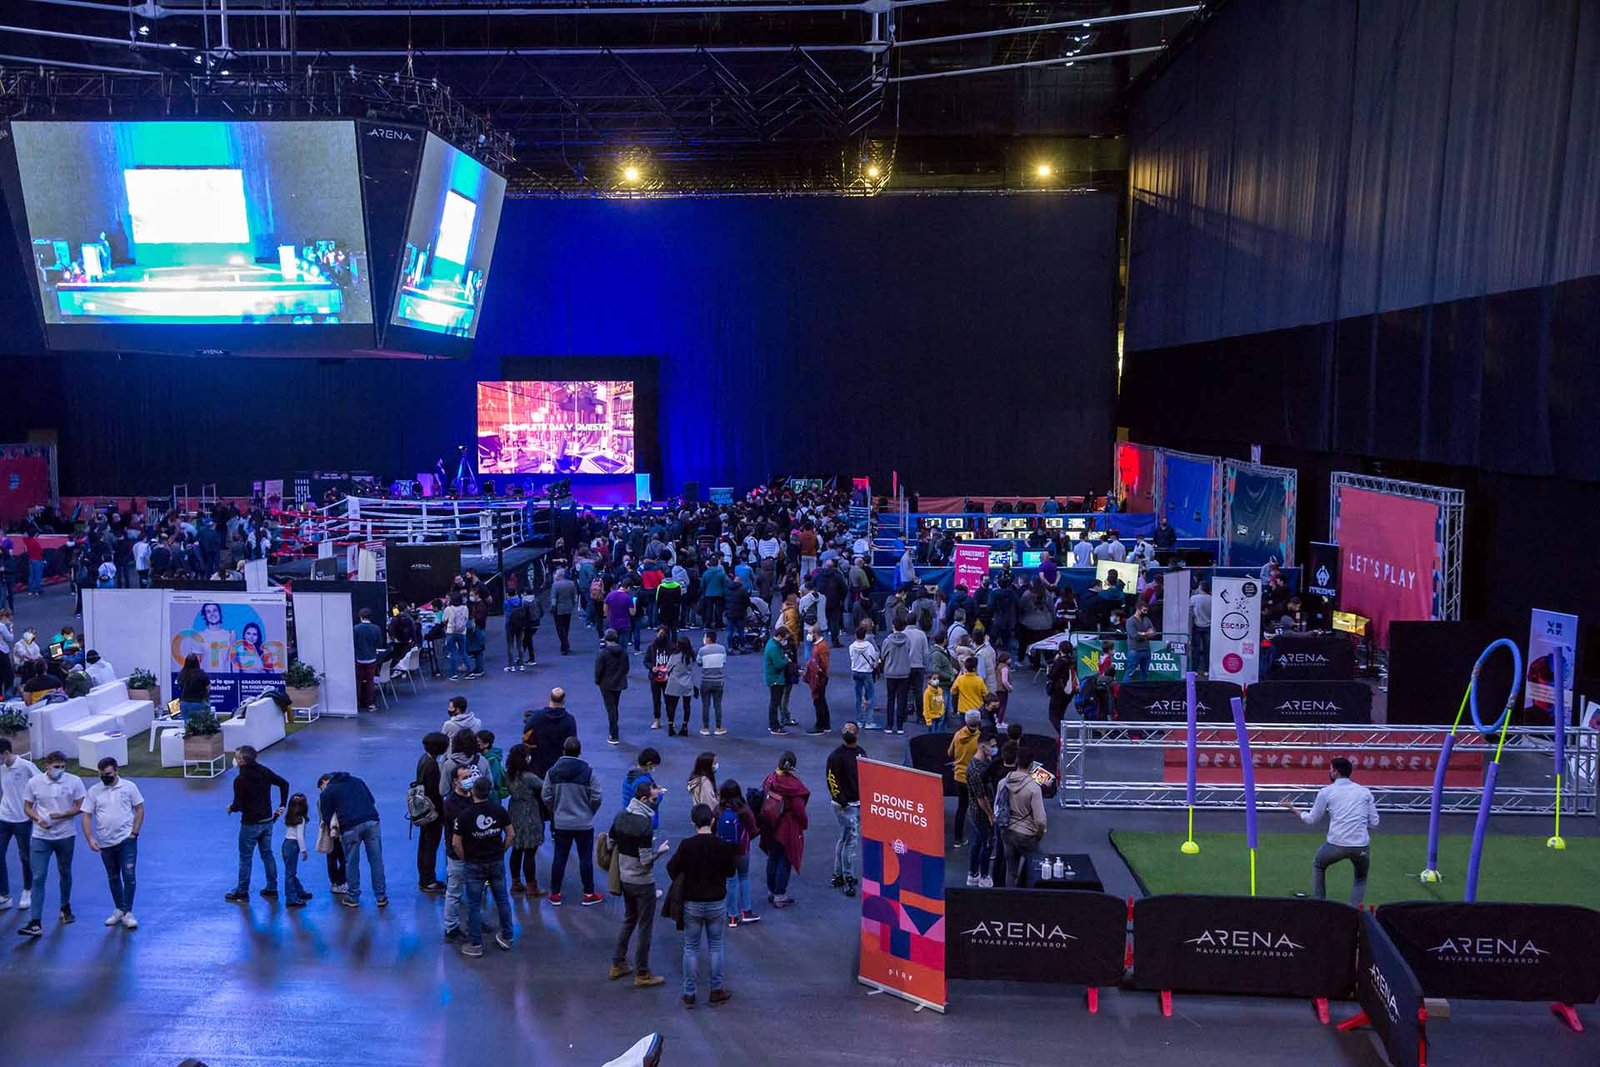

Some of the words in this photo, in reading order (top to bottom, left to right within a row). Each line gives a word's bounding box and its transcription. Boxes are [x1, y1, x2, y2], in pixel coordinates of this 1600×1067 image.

[366, 128, 414, 141] ARENA
[1350, 553, 1380, 578] LET'S
[1384, 563, 1416, 590] PLAY
[1277, 653, 1329, 662] ARENA
[1274, 700, 1343, 710] ARENA
[873, 792, 914, 811] DRONE
[917, 803, 925, 814] &
[870, 804, 928, 828] ROBOTICS
[960, 920, 1078, 940] ARENA
[1183, 930, 1304, 948] ARENA
[1427, 937, 1549, 955] ARENA
[1369, 963, 1400, 1019] ARENA
